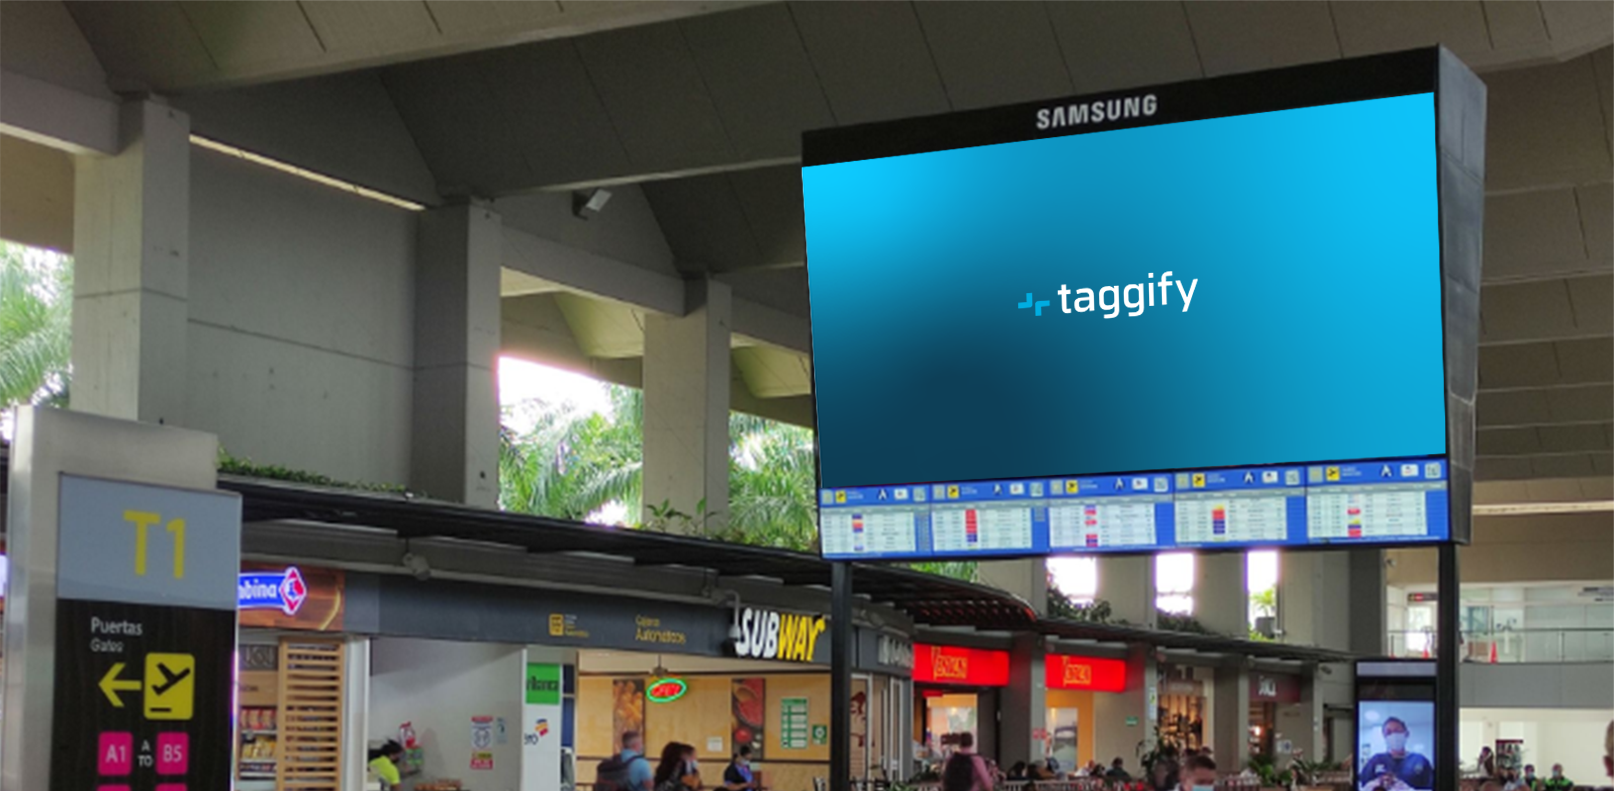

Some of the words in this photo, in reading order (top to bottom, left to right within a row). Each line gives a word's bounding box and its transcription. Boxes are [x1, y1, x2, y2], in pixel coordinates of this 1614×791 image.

[1036, 94, 1158, 130] SAMSUNG
[1057, 271, 1199, 319] taggify
[123, 509, 186, 580] T1
[91, 617, 143, 636] Puertas
[735, 607, 826, 662] SUBWAY
[106, 744, 127, 763] A1
[141, 739, 151, 752] A
[163, 744, 183, 763] B5
[137, 755, 153, 767] TO
